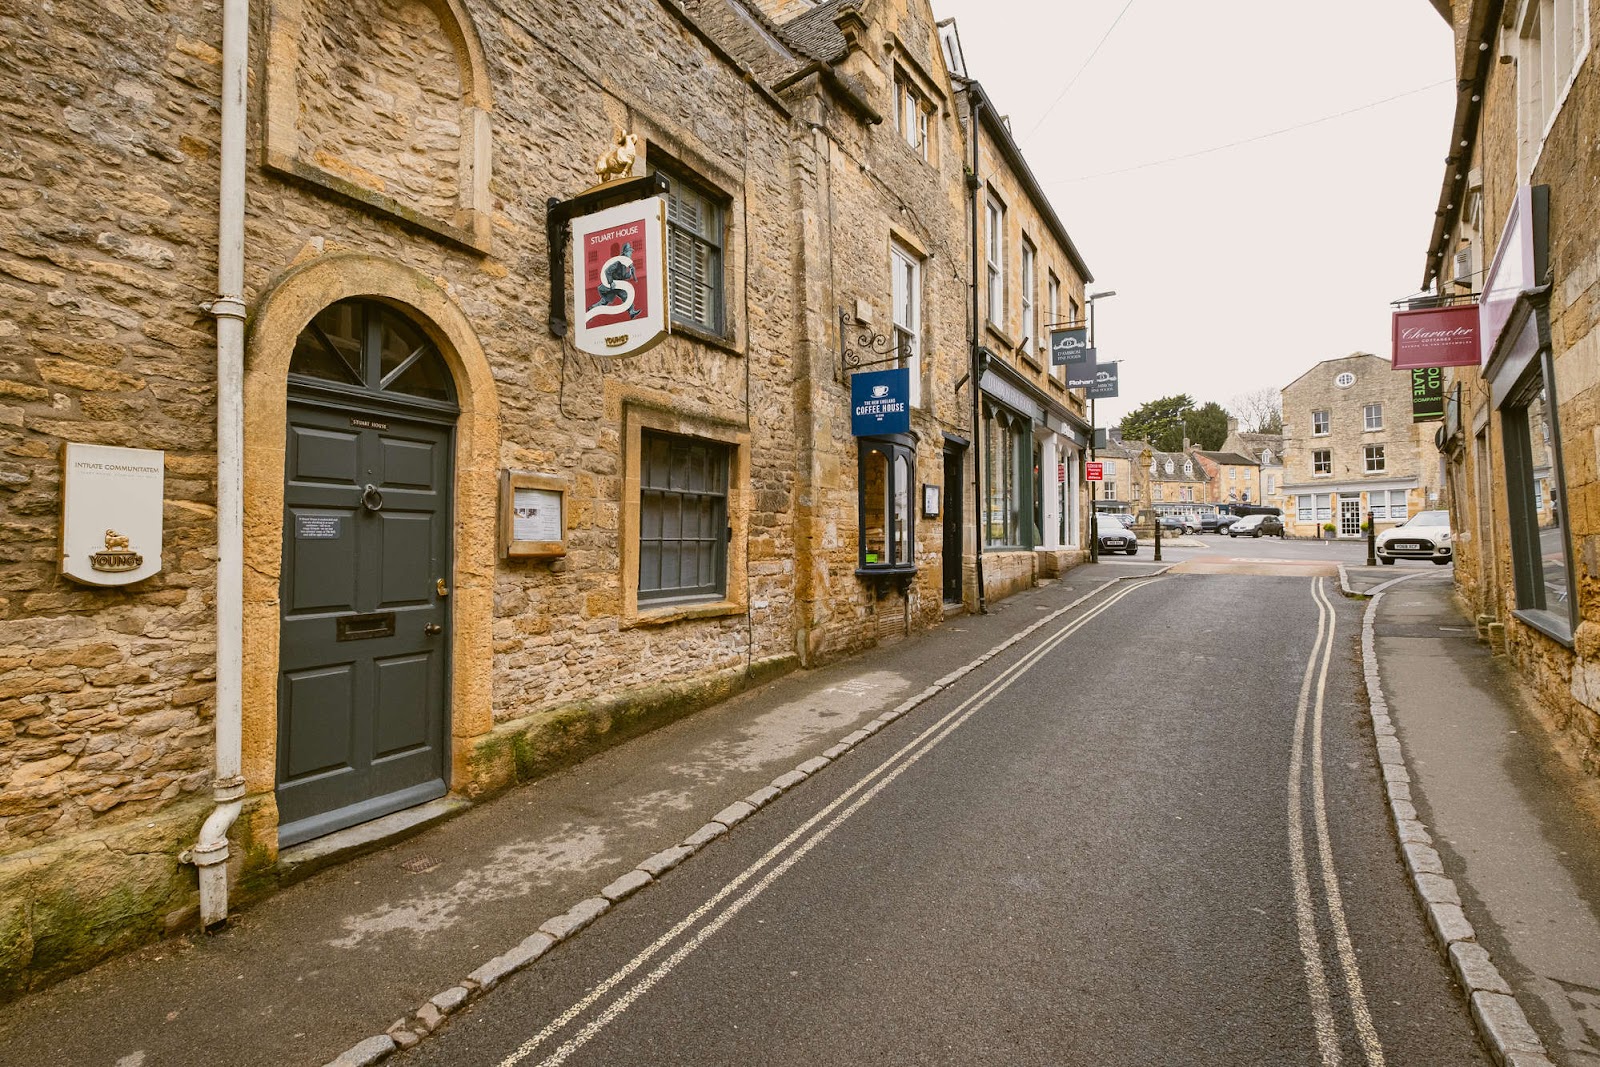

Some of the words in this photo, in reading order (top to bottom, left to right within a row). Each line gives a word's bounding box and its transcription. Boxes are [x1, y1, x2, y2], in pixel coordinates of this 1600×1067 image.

[590, 231, 615, 245] STUART
[615, 225, 639, 238] HOUSE
[1401, 326, 1473, 340] Character
[856, 405, 880, 415] COFFEE
[882, 402, 905, 412] HOUSE
[75, 462, 103, 470] INTRATE
[104, 464, 159, 473] COMMUNITATEM
